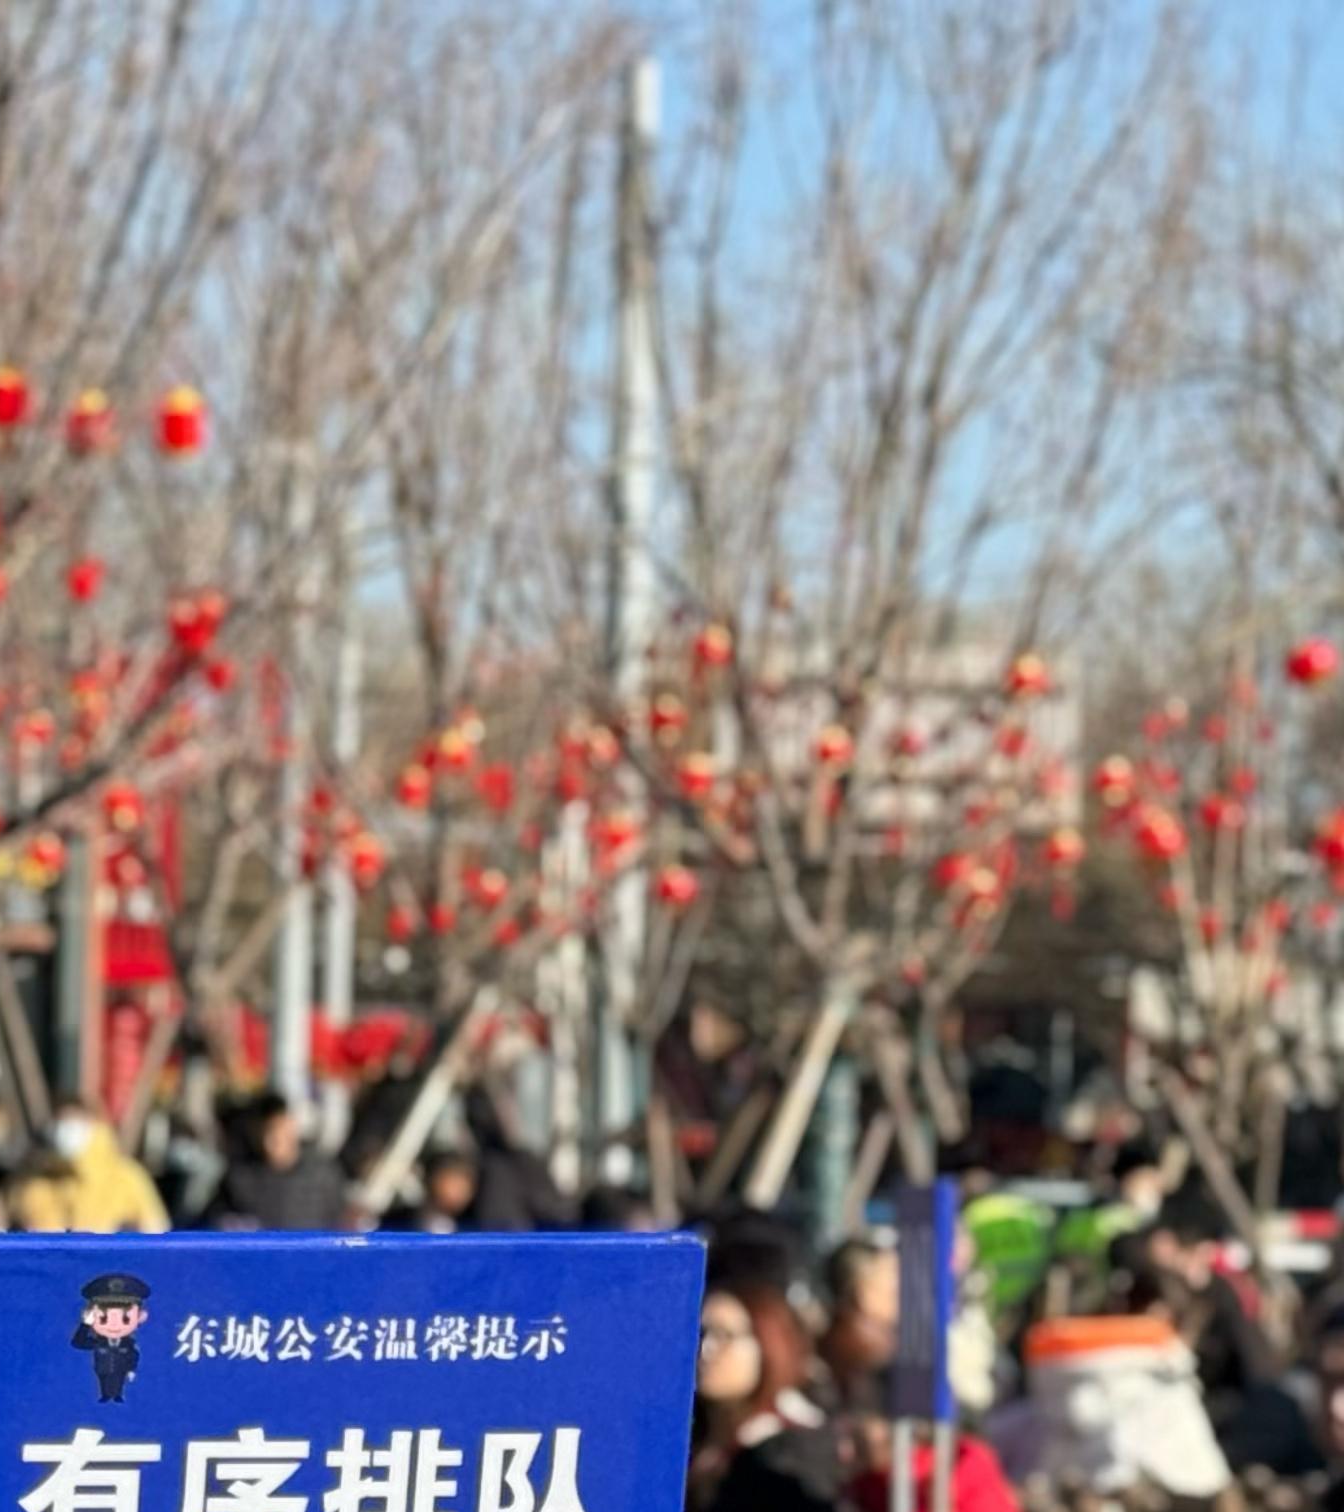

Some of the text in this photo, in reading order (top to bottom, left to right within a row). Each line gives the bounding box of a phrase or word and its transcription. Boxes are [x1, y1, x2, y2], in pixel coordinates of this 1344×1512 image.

[173, 1315, 568, 1363] 东城公安温馨提示
